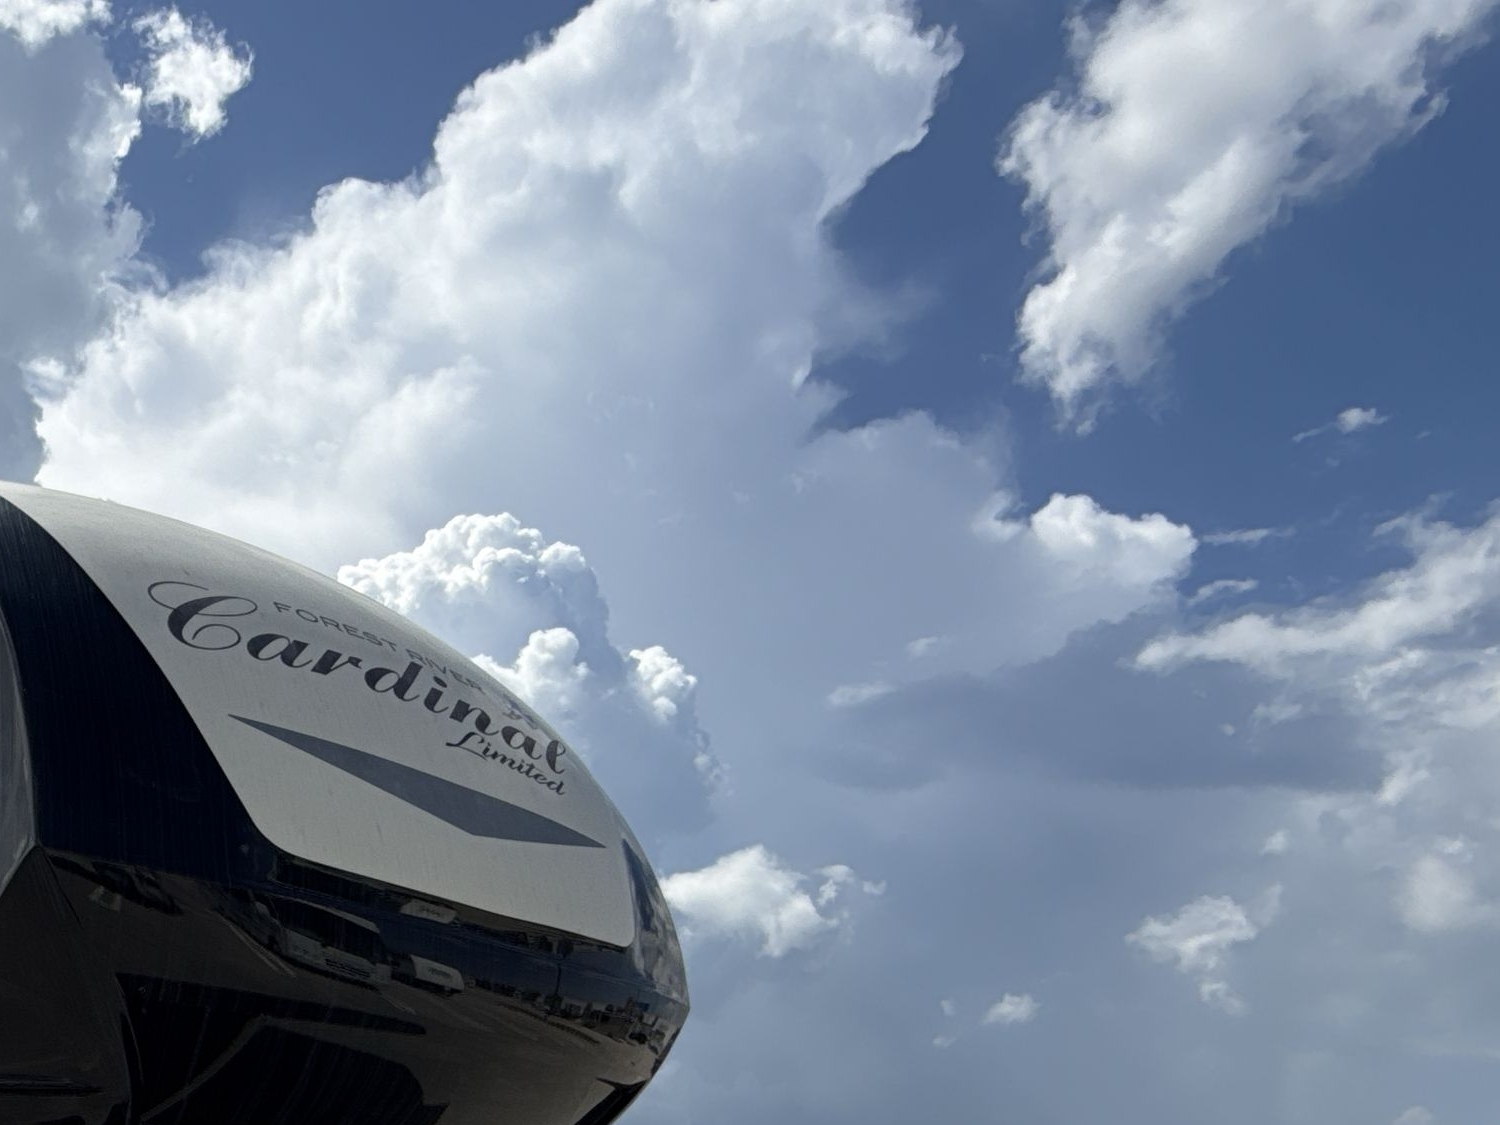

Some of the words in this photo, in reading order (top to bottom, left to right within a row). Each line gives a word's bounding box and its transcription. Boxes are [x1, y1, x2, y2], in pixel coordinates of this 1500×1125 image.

[147, 581, 566, 775] Cardinal
[272, 600, 398, 652] FOREST
[403, 647, 484, 696] RIVER
[445, 730, 567, 797] Limited
